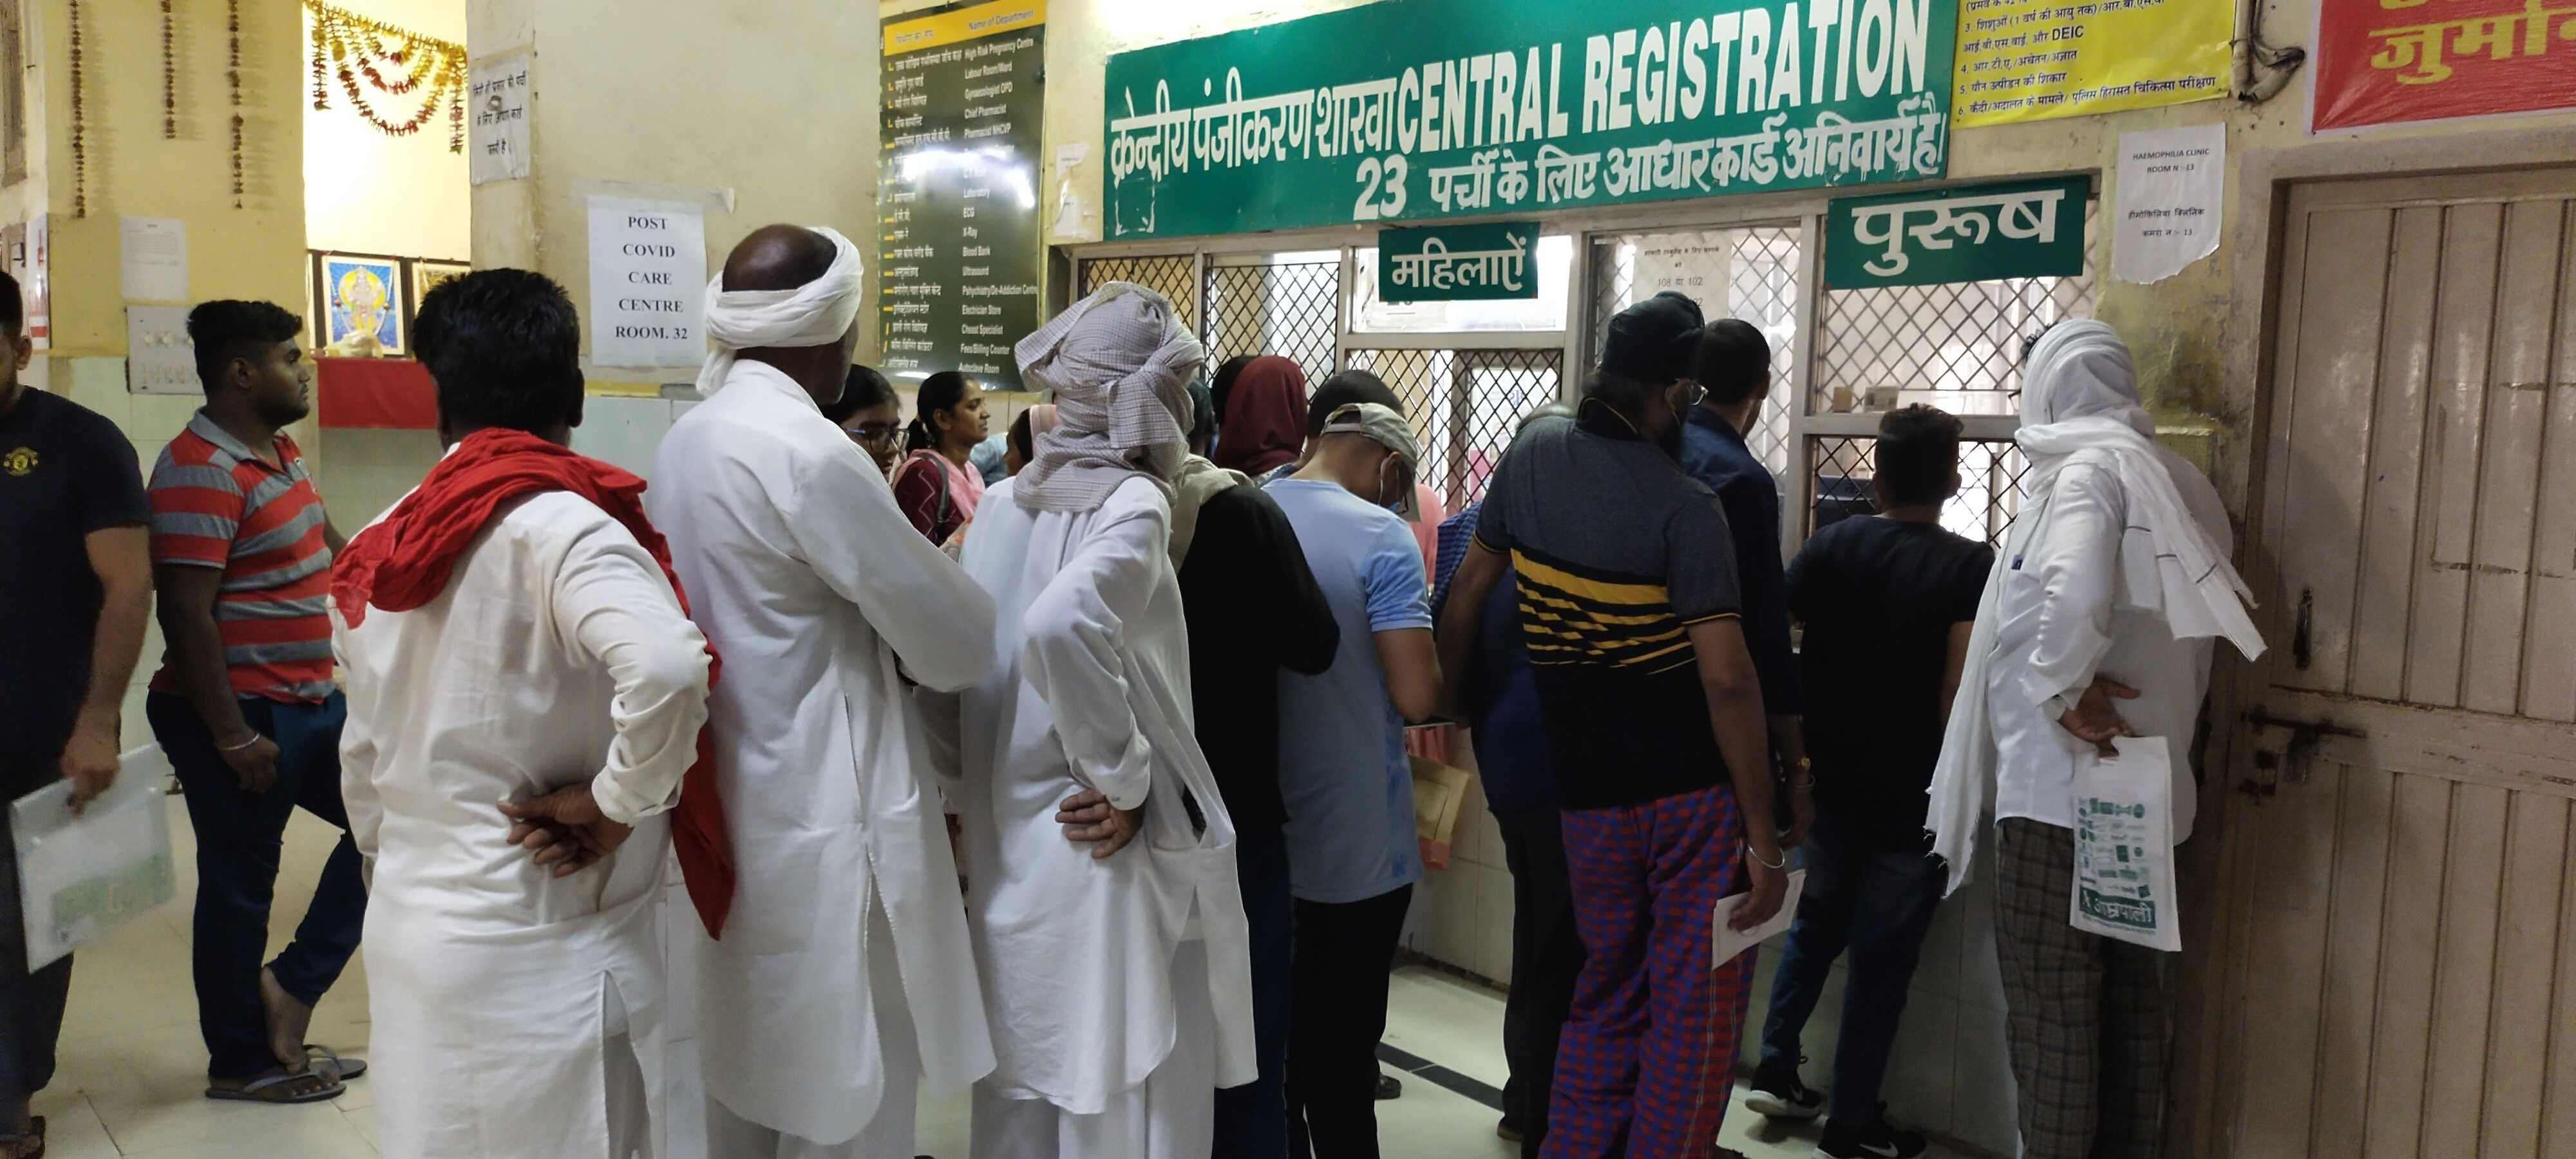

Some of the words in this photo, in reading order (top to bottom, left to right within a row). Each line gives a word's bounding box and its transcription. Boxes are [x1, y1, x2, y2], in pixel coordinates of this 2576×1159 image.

[969, 21, 986, 31] Name
[996, 10, 1034, 25] Department
[2023, 10, 2035, 22] वर्ष
[2040, 8, 2050, 20] की
[2055, 8, 2074, 20] आयु
[2033, 31, 2048, 42] और
[2052, 26, 2084, 41] DEIC
[965, 48, 976, 61] High
[978, 45, 989, 57] Risk
[989, 41, 1016, 56] Pregnancy
[1001, 82, 1013, 93] OPD
[1191, 67, 1315, 173] पंजीकरण
[1315, 77, 1397, 158] शाखा
[1397, 42, 1569, 155] CENTRAL
[1582, 0, 1933, 134] REGISTRATION
[1971, 80, 1987, 91] यौन
[2023, 73, 2035, 85] की
[2038, 72, 2066, 84] शिकार
[2027, 95, 2035, 107] के
[2072, 89, 2096, 104] पुलिस
[2134, 80, 2175, 93] चिकित्सा
[2179, 75, 2216, 89] परीक्षण
[2133, 149, 2184, 160] HAEMOPHILIA
[1354, 154, 1408, 221] 23
[1428, 149, 1499, 212] पर्ची
[1497, 149, 1529, 205] के
[1536, 144, 1600, 204] लिए
[963, 207, 974, 218] ECG
[628, 216, 668, 230] POST
[963, 227, 978, 239] X-Ray
[623, 243, 676, 258] COVID
[963, 247, 977, 257] Blood
[978, 245, 990, 256] Bank
[629, 272, 672, 285] CARE
[1658, 278, 1671, 287] 108
[1689, 277, 1703, 285] 102
[619, 299, 684, 312] CENTRE
[616, 326, 668, 339] ROOM.
[673, 328, 688, 339] 32
[990, 344, 1010, 355] Counter
[984, 364, 999, 374] Room
